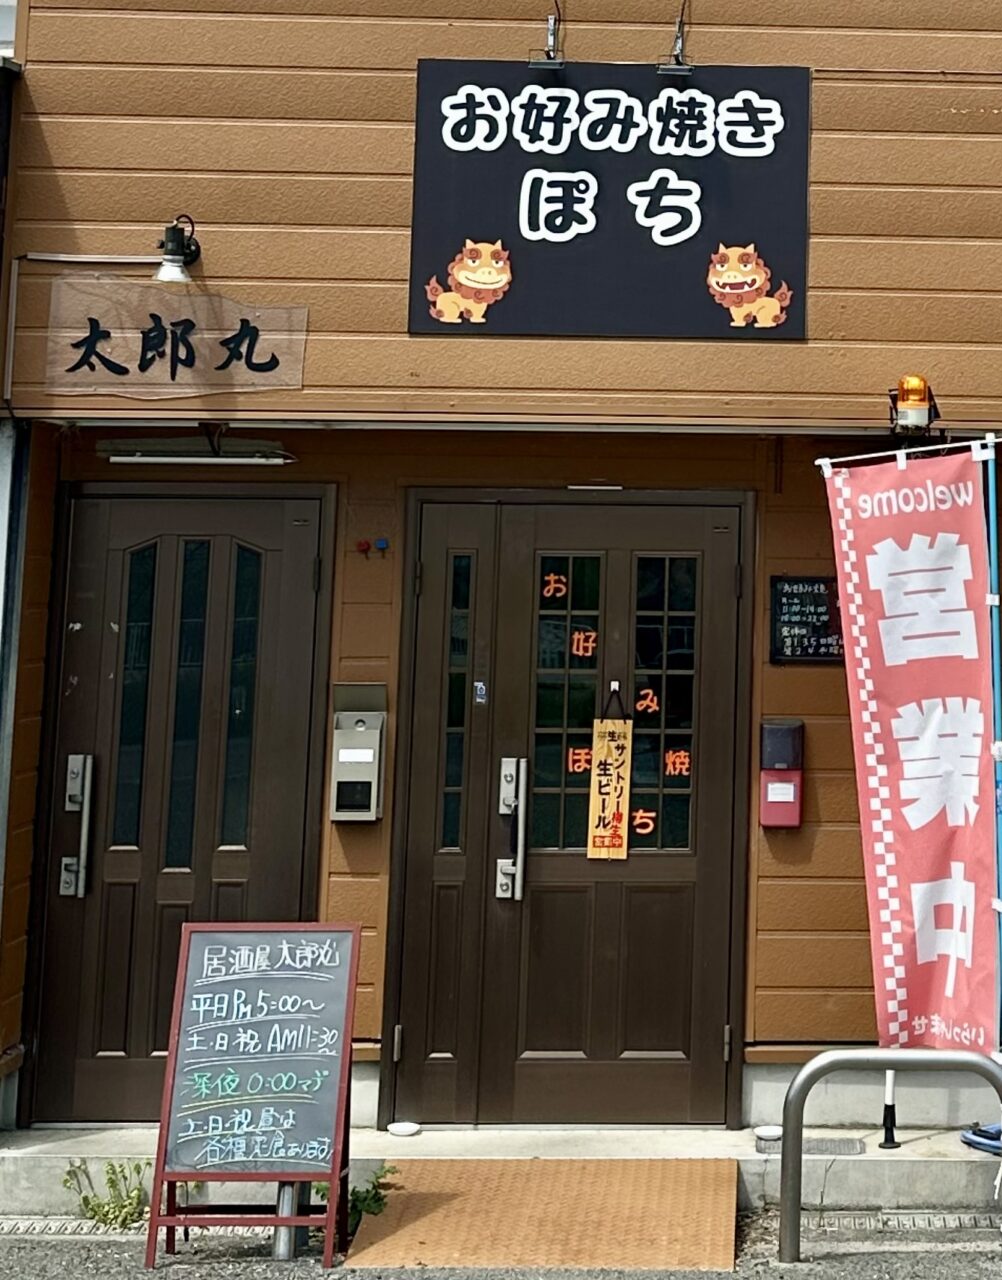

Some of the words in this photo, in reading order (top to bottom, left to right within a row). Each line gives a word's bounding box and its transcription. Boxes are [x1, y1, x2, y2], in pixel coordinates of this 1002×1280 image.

[442, 84, 785, 158] お好み焼き
[65, 313, 281, 383] 太郎丸
[543, 574, 567, 598] お
[572, 631, 597, 656] 好
[636, 690, 659, 713] み
[665, 750, 691, 776] 焼
[614, 743, 627, 811] サントリー
[595, 759, 613, 829] 生ビール
[632, 809, 657, 834] ち
